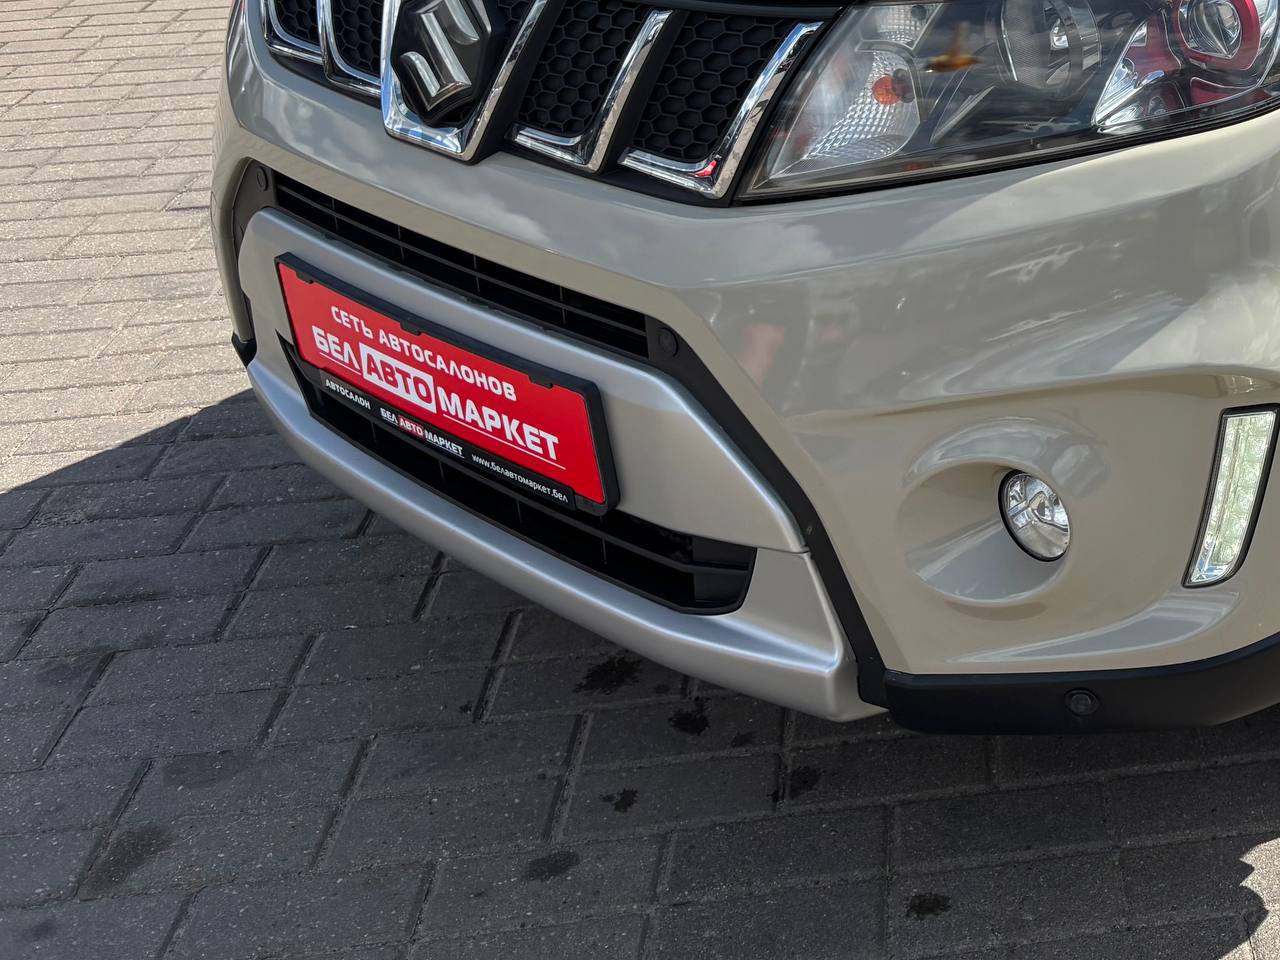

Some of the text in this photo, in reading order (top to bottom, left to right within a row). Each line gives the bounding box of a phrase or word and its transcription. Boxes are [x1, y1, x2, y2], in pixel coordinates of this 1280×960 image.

[330, 305, 517, 401] СЕТЬ АВТОСАЛОНОВ
[325, 379, 371, 410] АВТОСАЛОН
[399, 417, 423, 436] АВТО
[424, 430, 463, 455] МАРКЕТ
